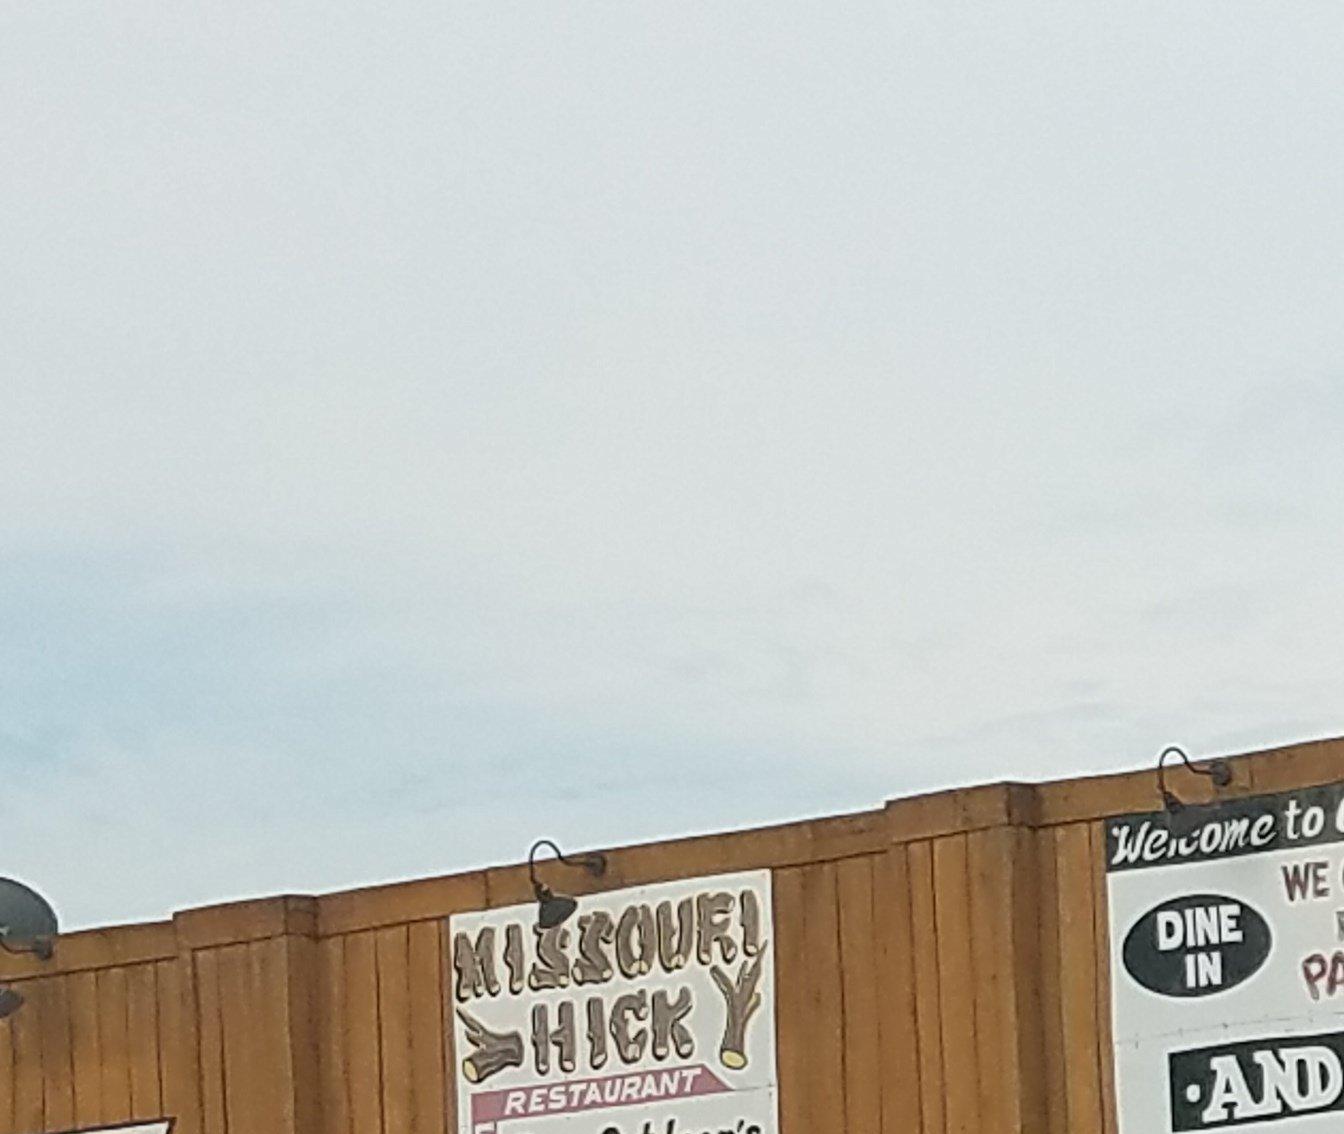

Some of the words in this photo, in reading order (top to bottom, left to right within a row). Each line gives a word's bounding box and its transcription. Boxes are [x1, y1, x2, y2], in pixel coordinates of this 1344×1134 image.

[1284, 799, 1325, 839] to
[1281, 860, 1330, 901] WE
[454, 889, 760, 1003] MISSOURI
[1157, 903, 1243, 951] DINE
[1186, 950, 1222, 988] IN
[532, 987, 695, 1075] HICK
[504, 1067, 701, 1115] RESTAURANT
[1200, 1045, 1343, 1124] AND
